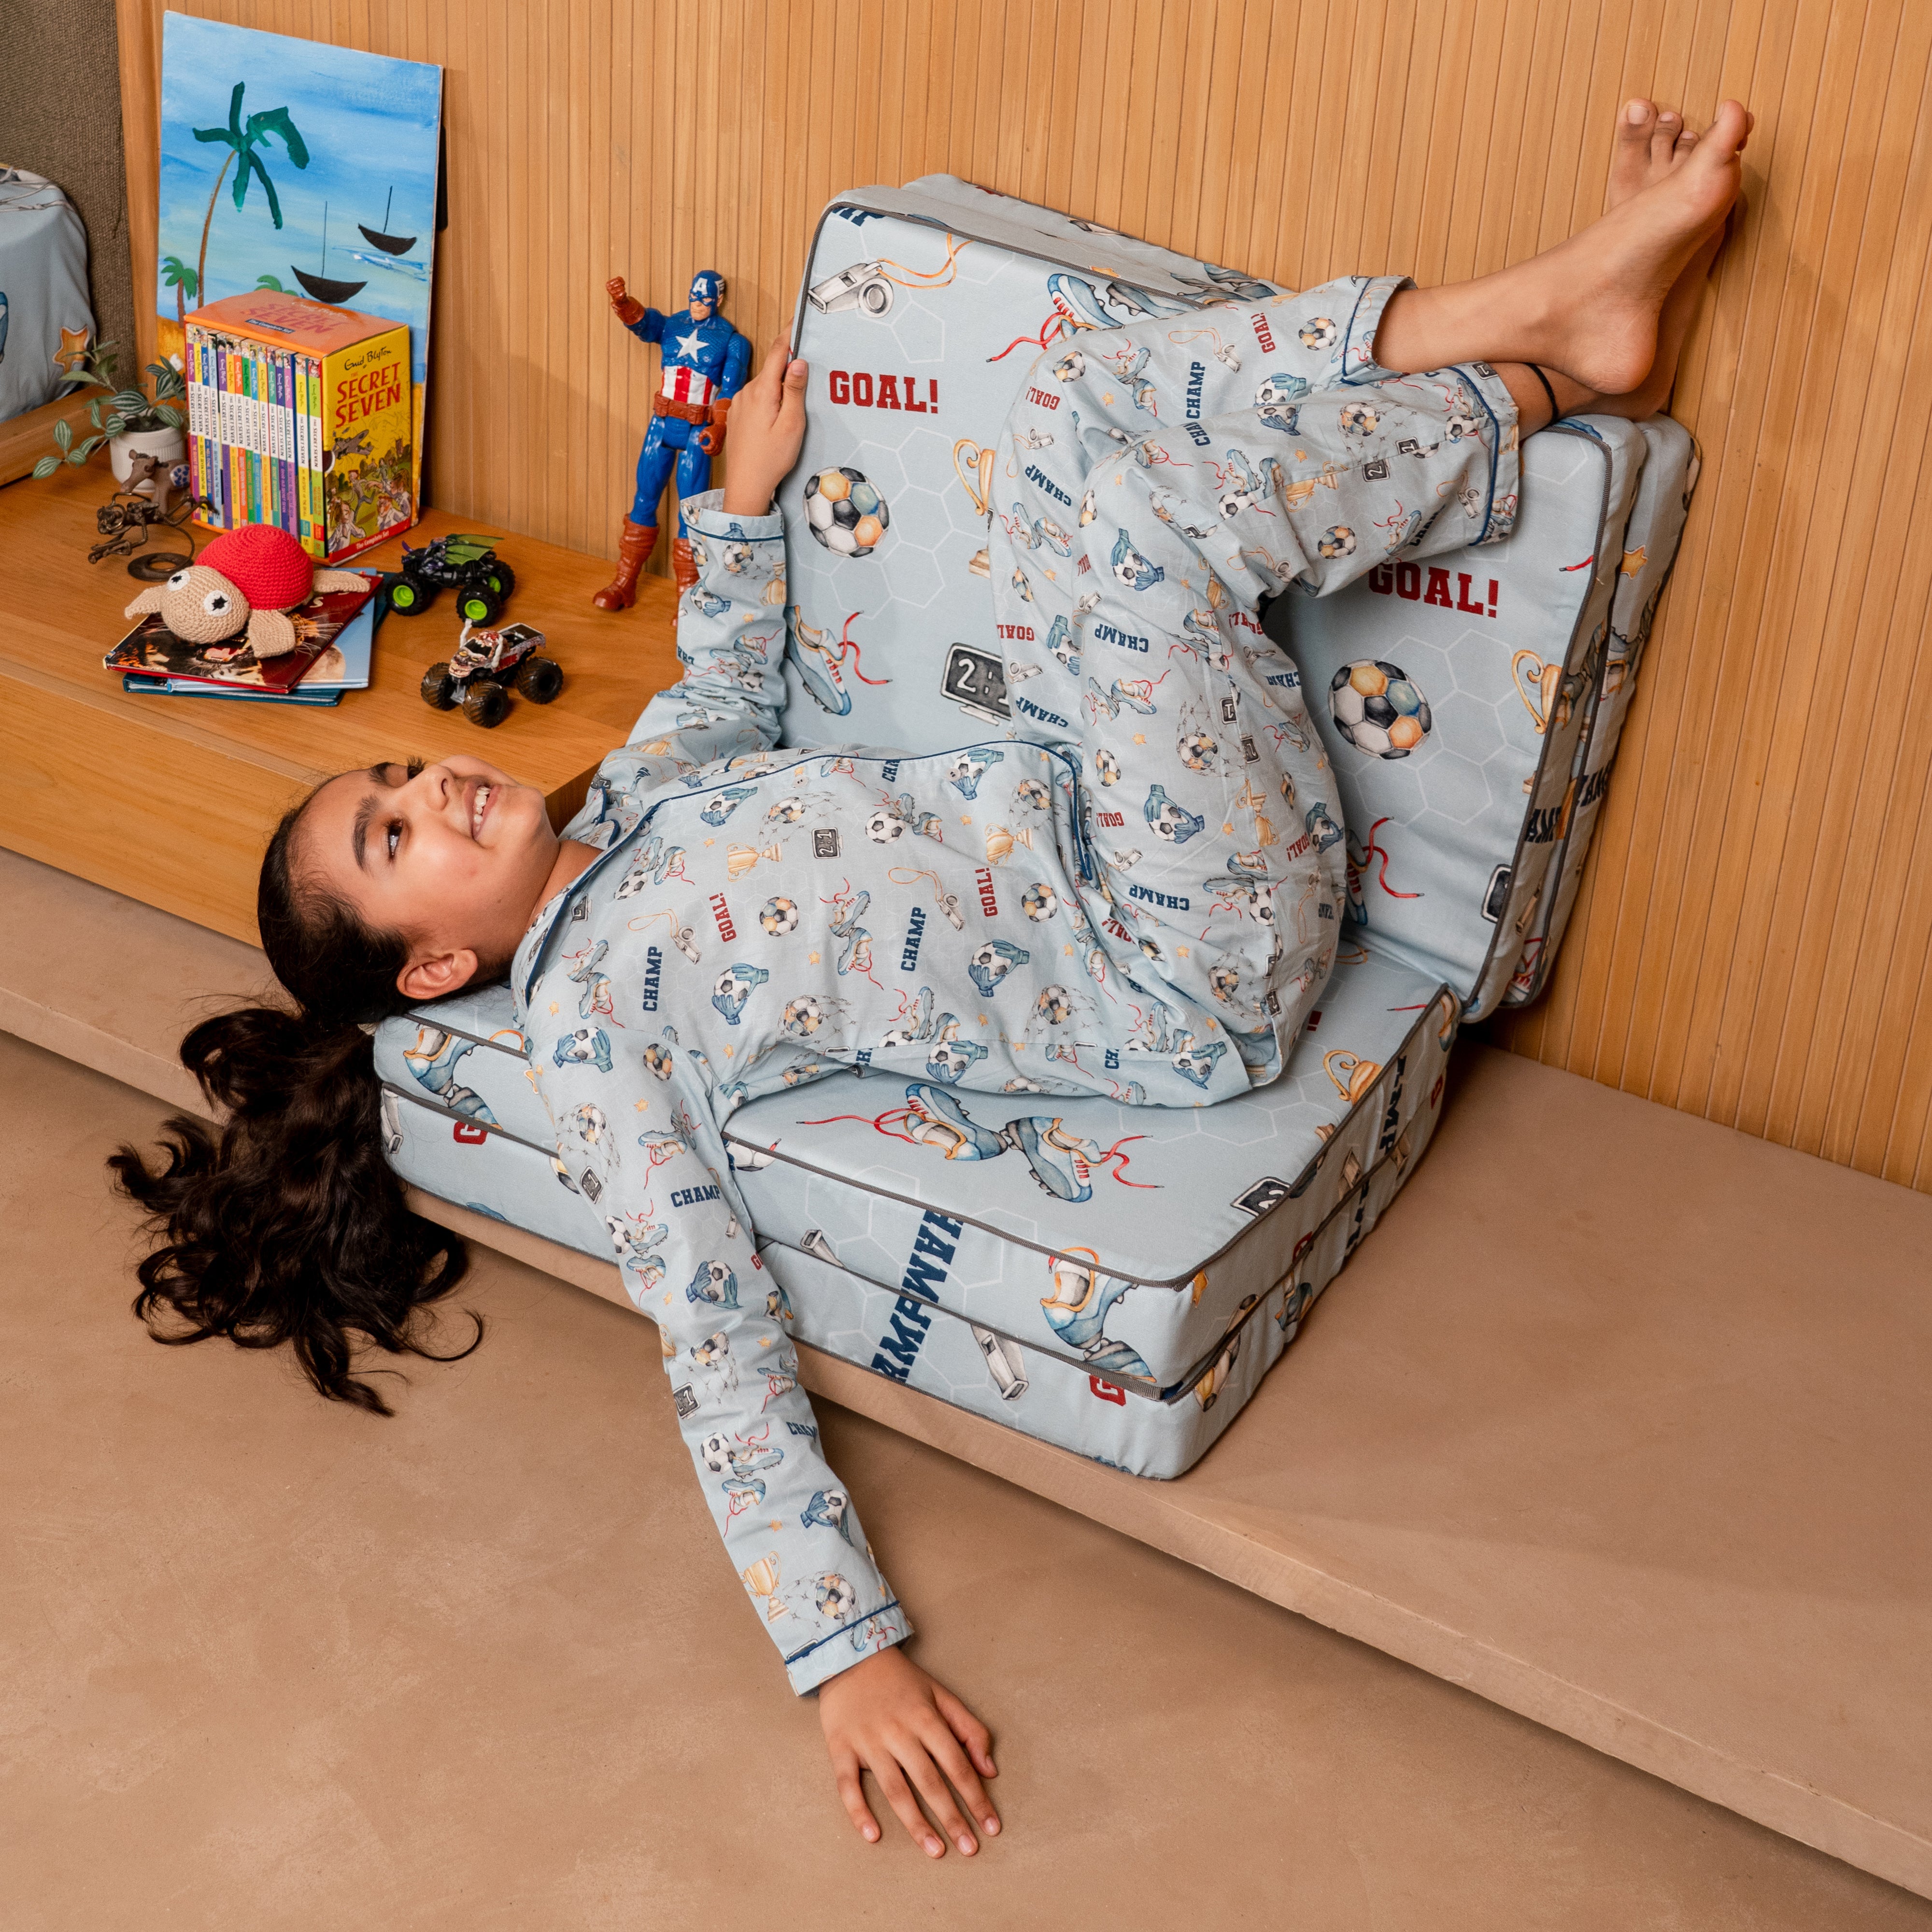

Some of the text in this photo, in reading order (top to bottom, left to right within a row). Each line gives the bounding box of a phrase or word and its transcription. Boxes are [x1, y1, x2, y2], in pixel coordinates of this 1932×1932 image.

[1250, 312, 1276, 354] GOAL!
[344, 346, 392, 370] Enid Blyton
[337, 362, 401, 404] SECRET
[829, 370, 938, 414] GOAL!
[1186, 361, 1206, 419] CHAMP
[336, 383, 401, 428] SEVEN
[1025, 386, 1060, 410] GOAL!
[1179, 422, 1210, 446] CHA
[1024, 464, 1072, 507] CHAMP
[1368, 562, 1499, 618] GOAL!
[997, 625, 1035, 641] GOAL
[1228, 611, 1264, 635] GOAL!
[1094, 624, 1149, 653] CHAMP
[1266, 671, 1301, 688] CHAM
[1016, 696, 1069, 728] CHAMP
[882, 760, 900, 782] CHA
[1096, 812, 1124, 827] GOAL!
[816, 831, 834, 855] 2:1
[975, 867, 998, 917] GOAL!
[1129, 884, 1190, 911] CHAMP
[709, 892, 737, 942] GOAL!
[900, 906, 926, 971] CHAMP
[1101, 918, 1136, 945] OAL!
[643, 946, 663, 1012] CHAMP
[670, 1184, 720, 1208] CHAMP
[786, 1421, 818, 1442] CHAM
